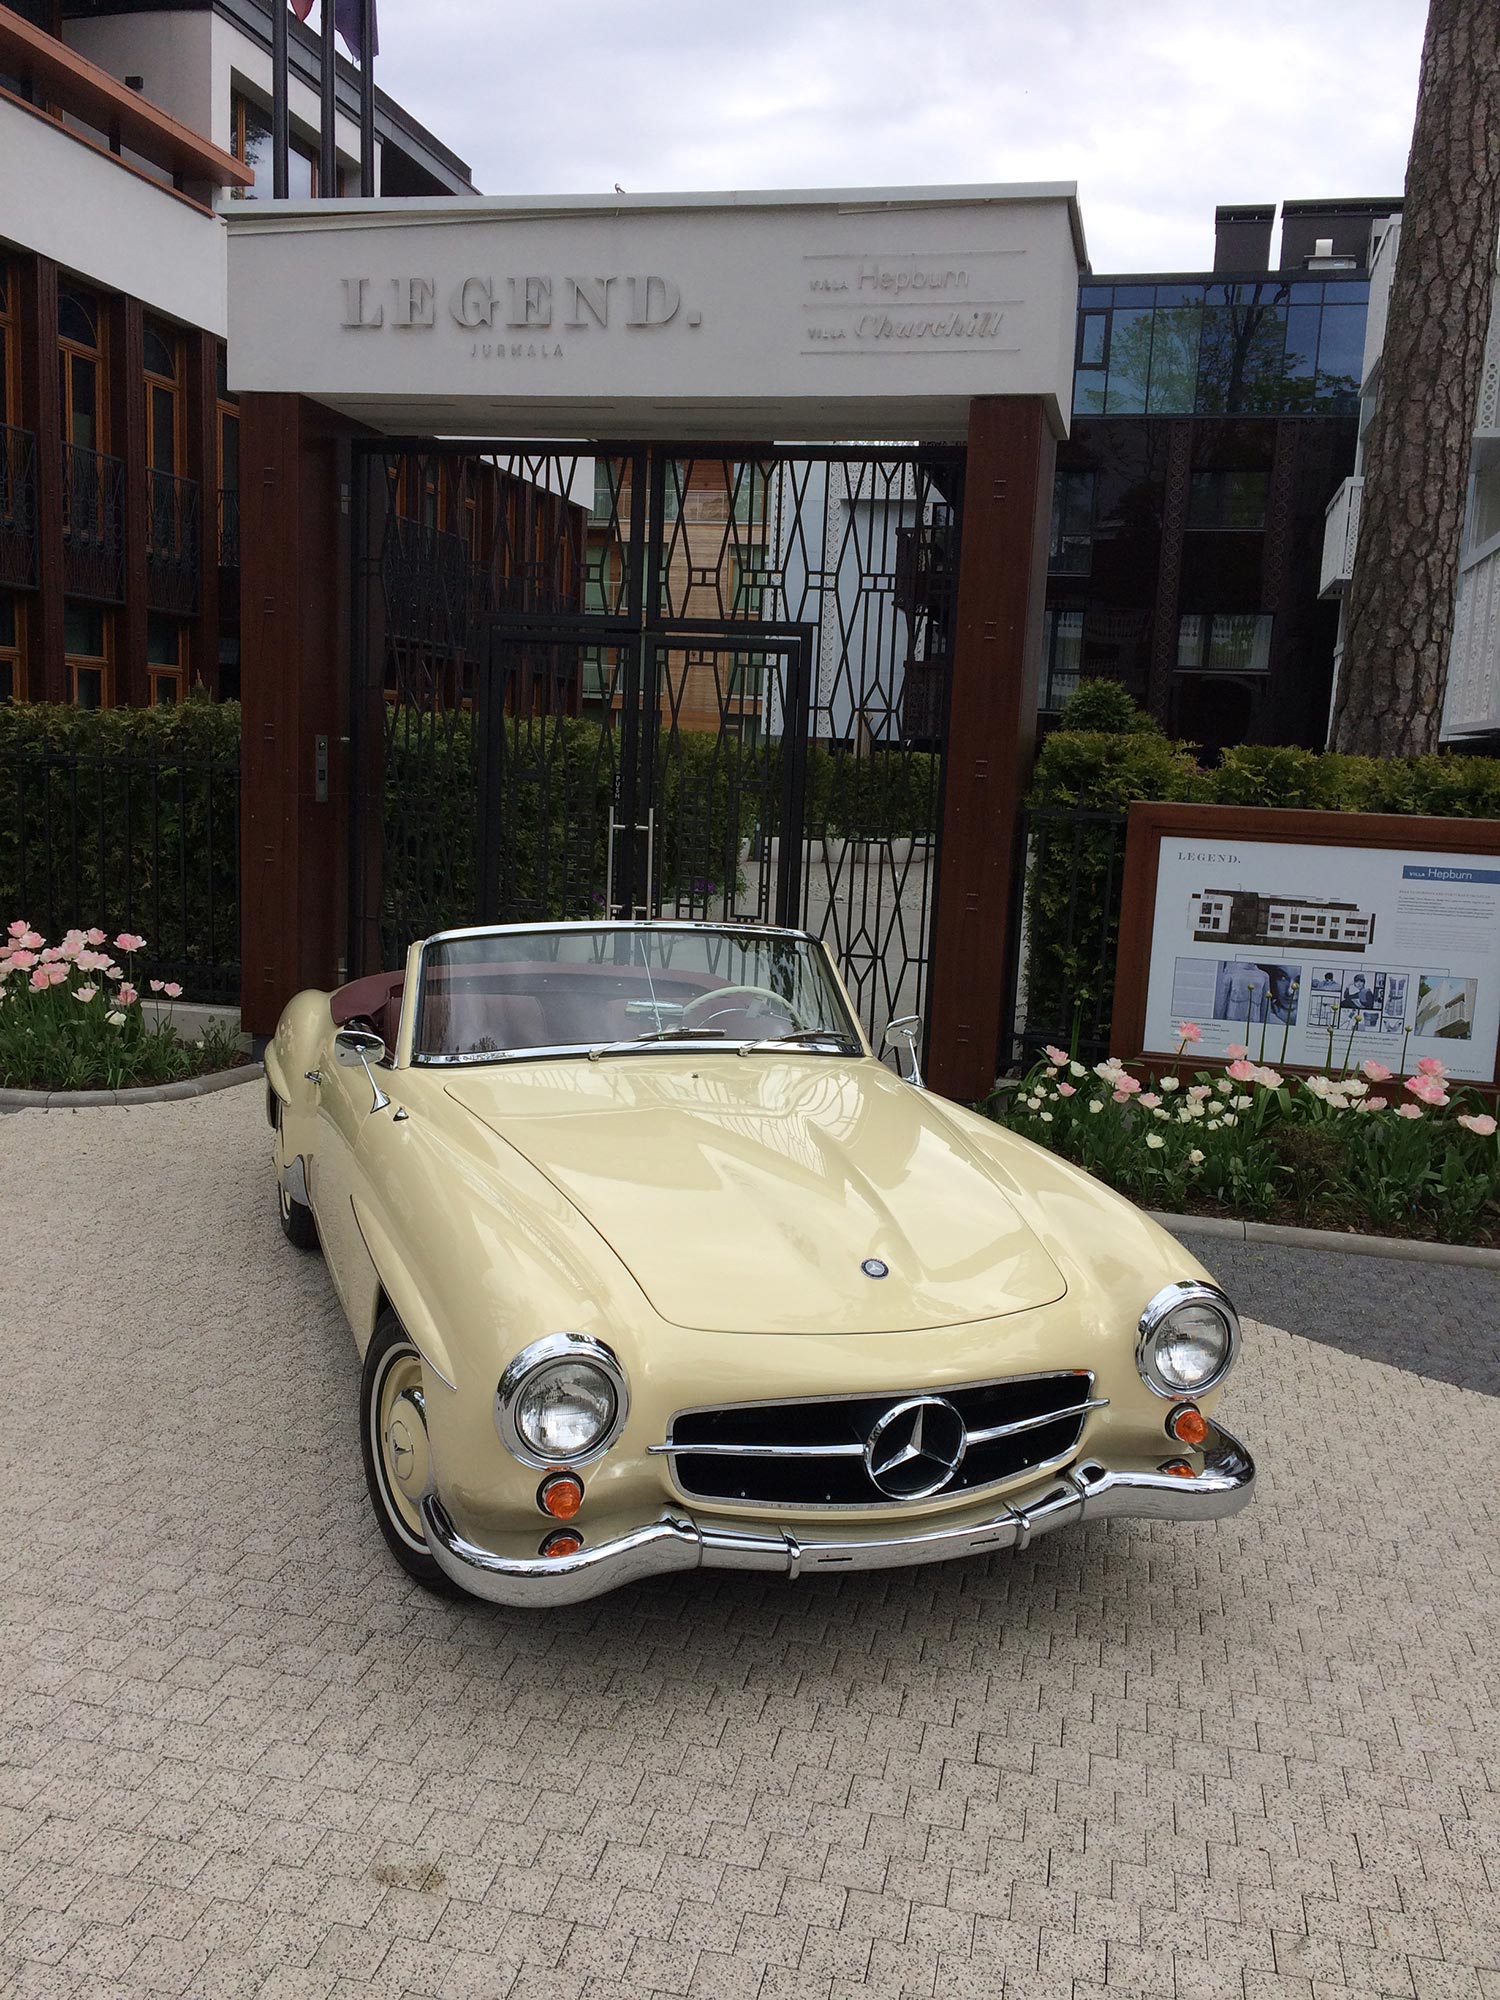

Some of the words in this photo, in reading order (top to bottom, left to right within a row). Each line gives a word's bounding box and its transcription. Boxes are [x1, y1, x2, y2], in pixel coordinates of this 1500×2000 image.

[809, 280, 849, 292] VILLA
[857, 263, 970, 295] Hepburn
[340, 275, 702, 328] LEGEND.
[807, 327, 847, 339] VILLA
[854, 311, 1004, 338] Churchill
[1178, 851, 1241, 864] LEGEND.
[1428, 868, 1473, 880] Hepburn
